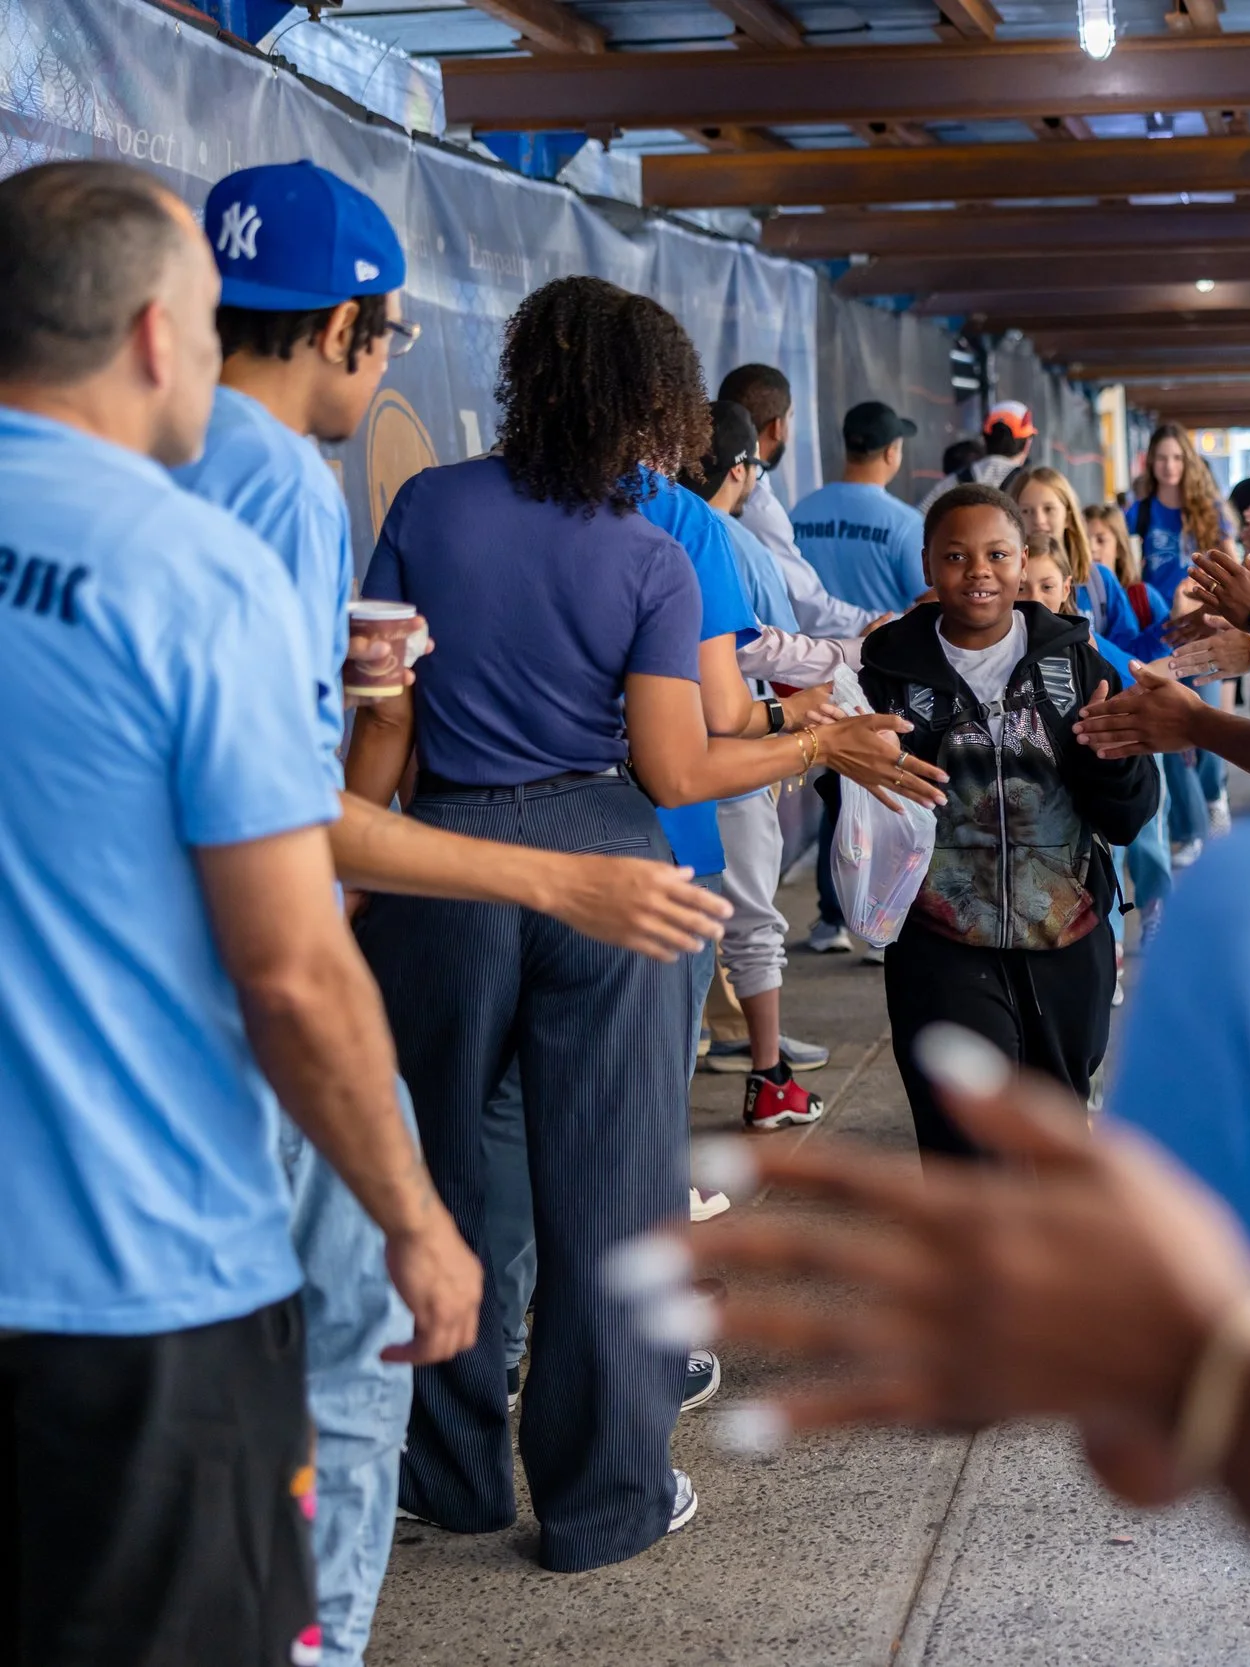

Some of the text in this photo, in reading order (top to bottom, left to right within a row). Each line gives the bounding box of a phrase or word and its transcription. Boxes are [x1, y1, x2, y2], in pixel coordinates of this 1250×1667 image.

[217, 201, 262, 260] NY
[793, 519, 890, 544] Proud Parent
